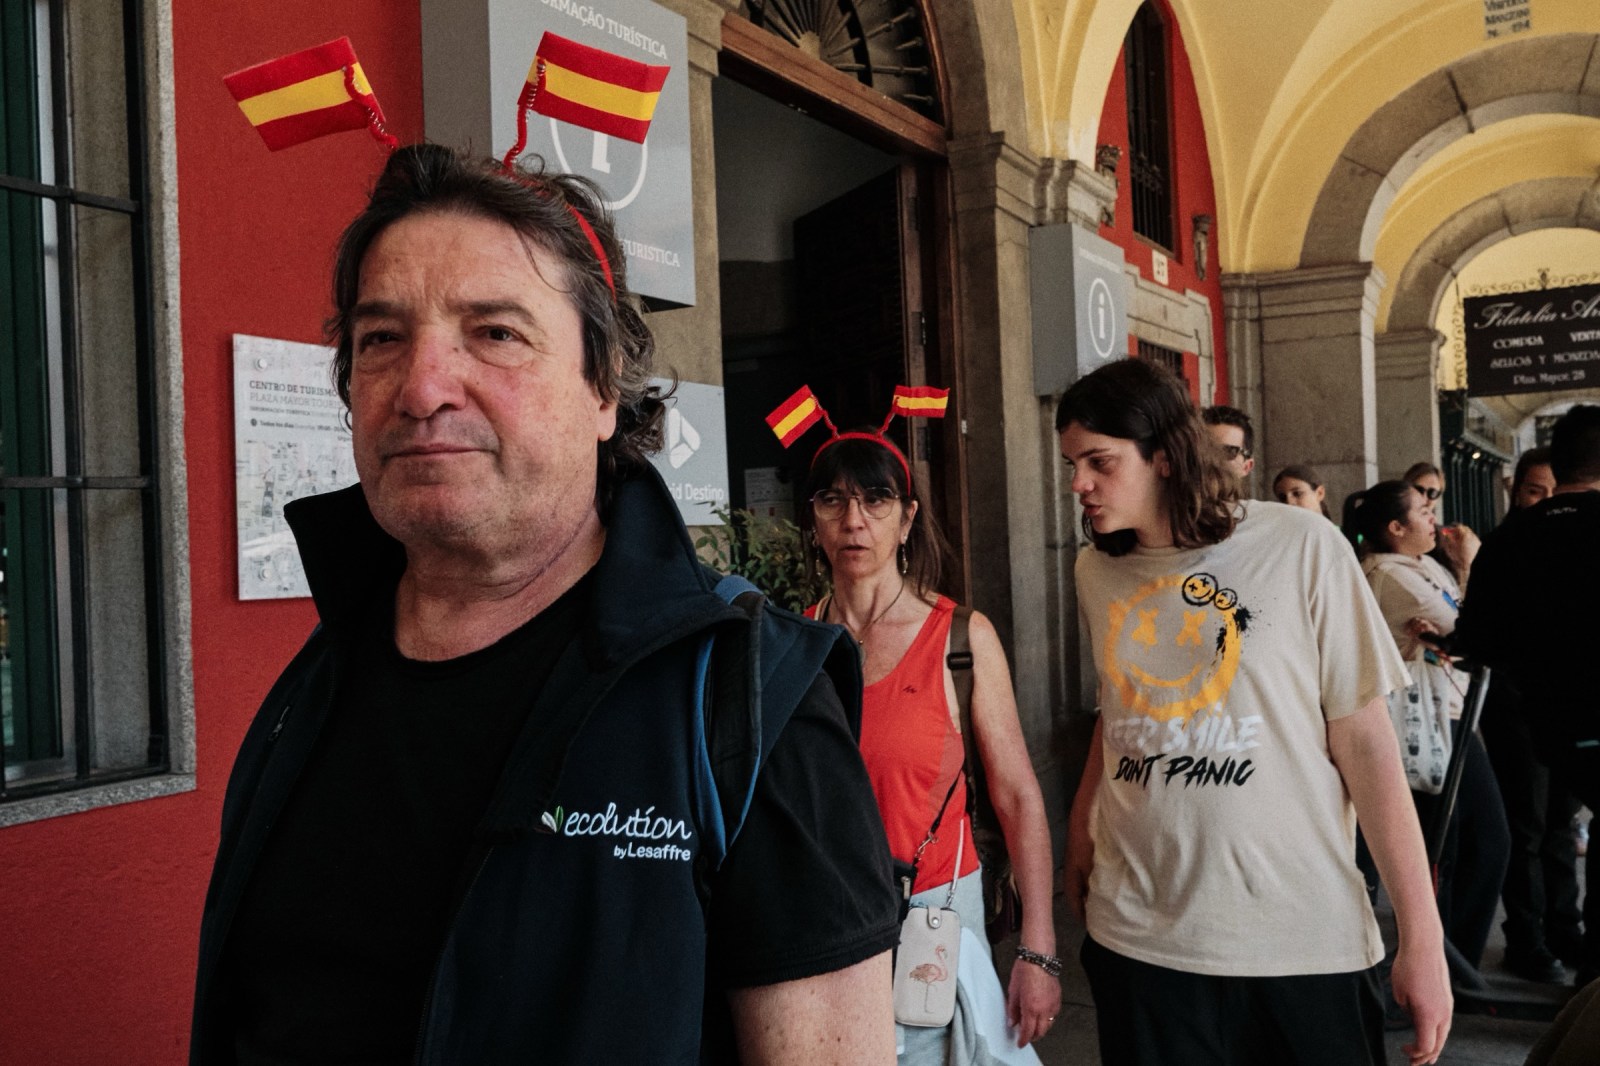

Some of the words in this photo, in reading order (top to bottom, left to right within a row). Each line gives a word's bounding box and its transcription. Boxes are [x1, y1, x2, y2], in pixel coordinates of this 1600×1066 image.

[540, 0, 605, 30] RMAÇÃO
[606, 18, 667, 59] TURÍSTICA
[1473, 302, 1557, 329] Filatelia
[1492, 335, 1544, 350] COMPRA
[1490, 356, 1532, 369] SELLOS
[1538, 355, 1547, 365] Y
[249, 380, 286, 392] CENTRO
[287, 384, 298, 394] DE
[249, 392, 279, 403] PLAZA
[280, 395, 310, 406] MAYOR
[685, 484, 724, 500] Destino
[1162, 755, 1256, 790] PANIC
[564, 802, 692, 840] ecolutión
[614, 845, 627, 859] by
[627, 842, 691, 861] Lesaffre
